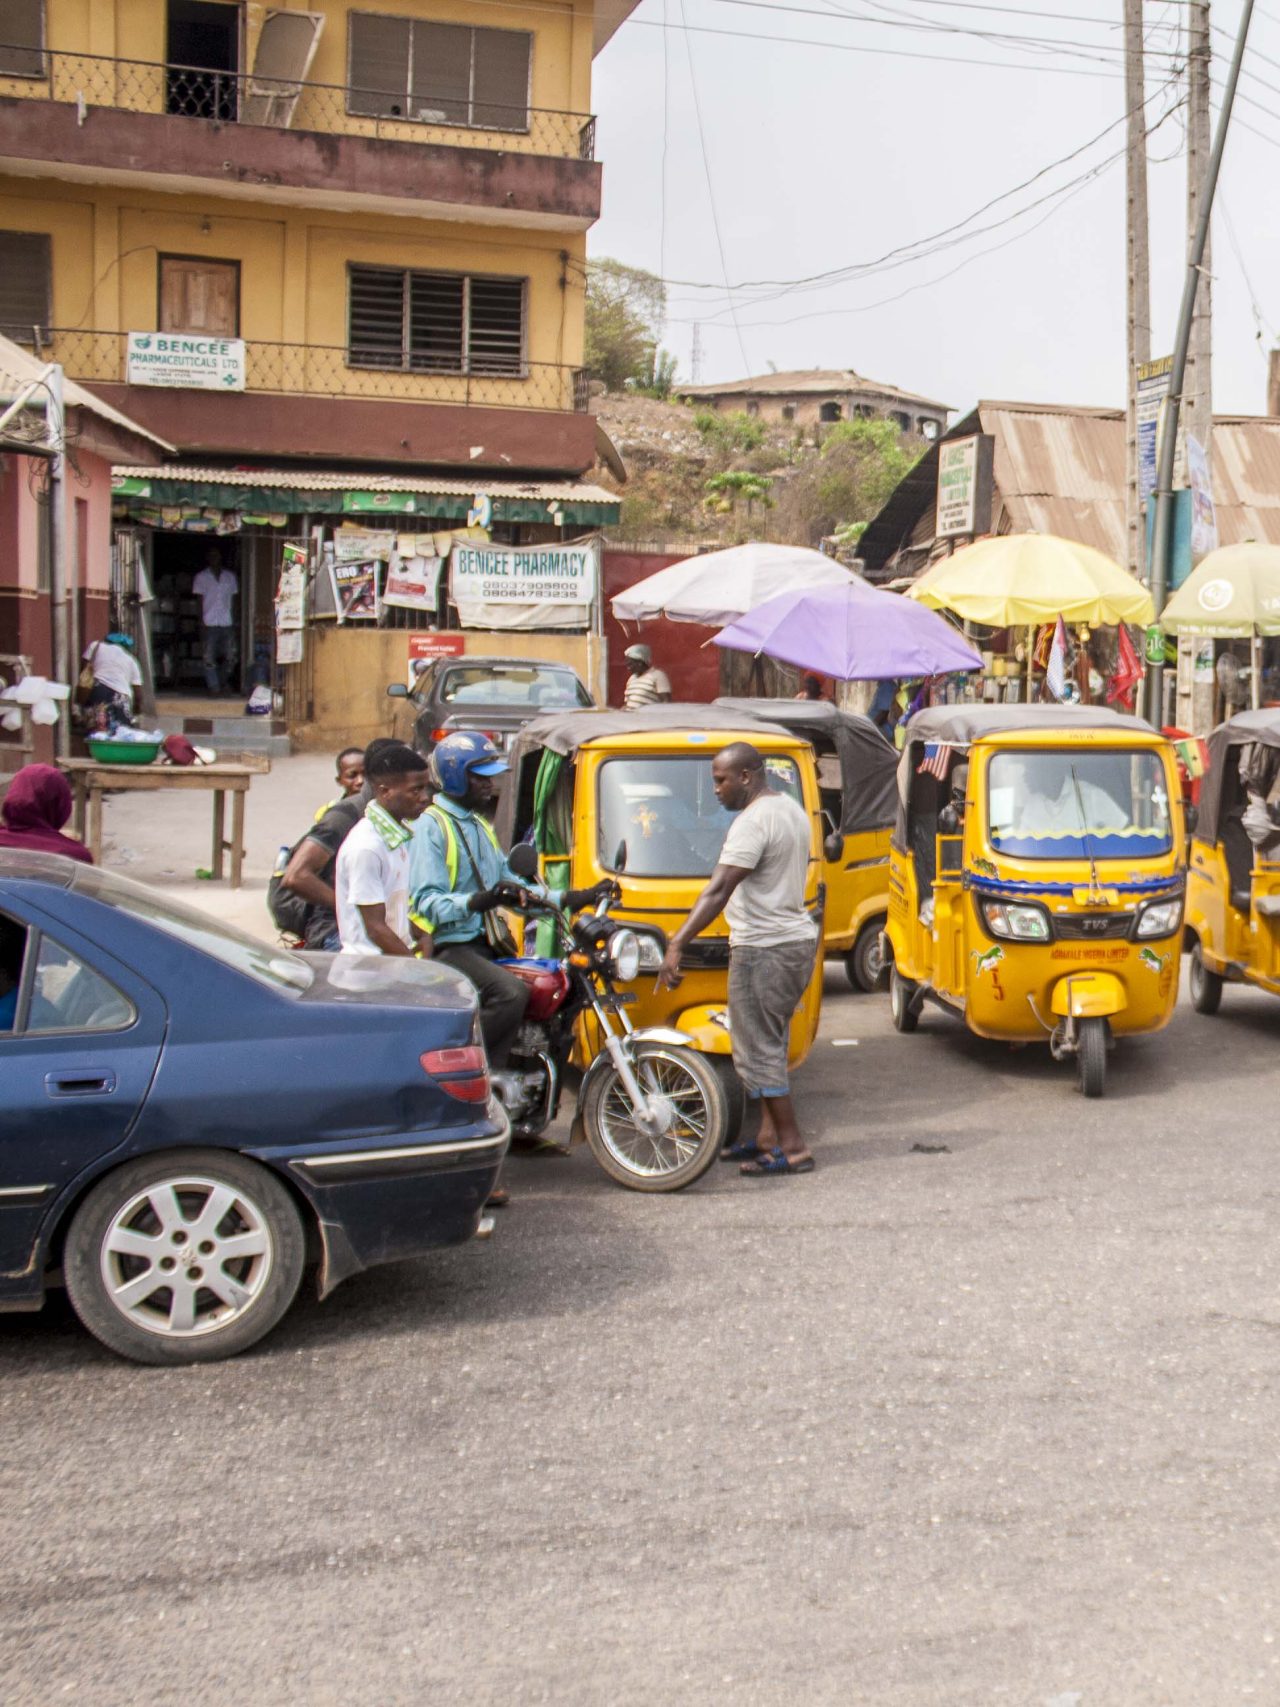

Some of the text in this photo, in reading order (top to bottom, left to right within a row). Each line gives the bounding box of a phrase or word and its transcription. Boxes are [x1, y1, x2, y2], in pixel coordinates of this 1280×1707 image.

[157, 339, 229, 356] BENCEE
[130, 352, 217, 368] PHARMACEUTICALS
[459, 550, 587, 577] BENCEE PHARMACY
[482, 589, 578, 598] 08064783235
[1082, 919, 1109, 930] TVS
